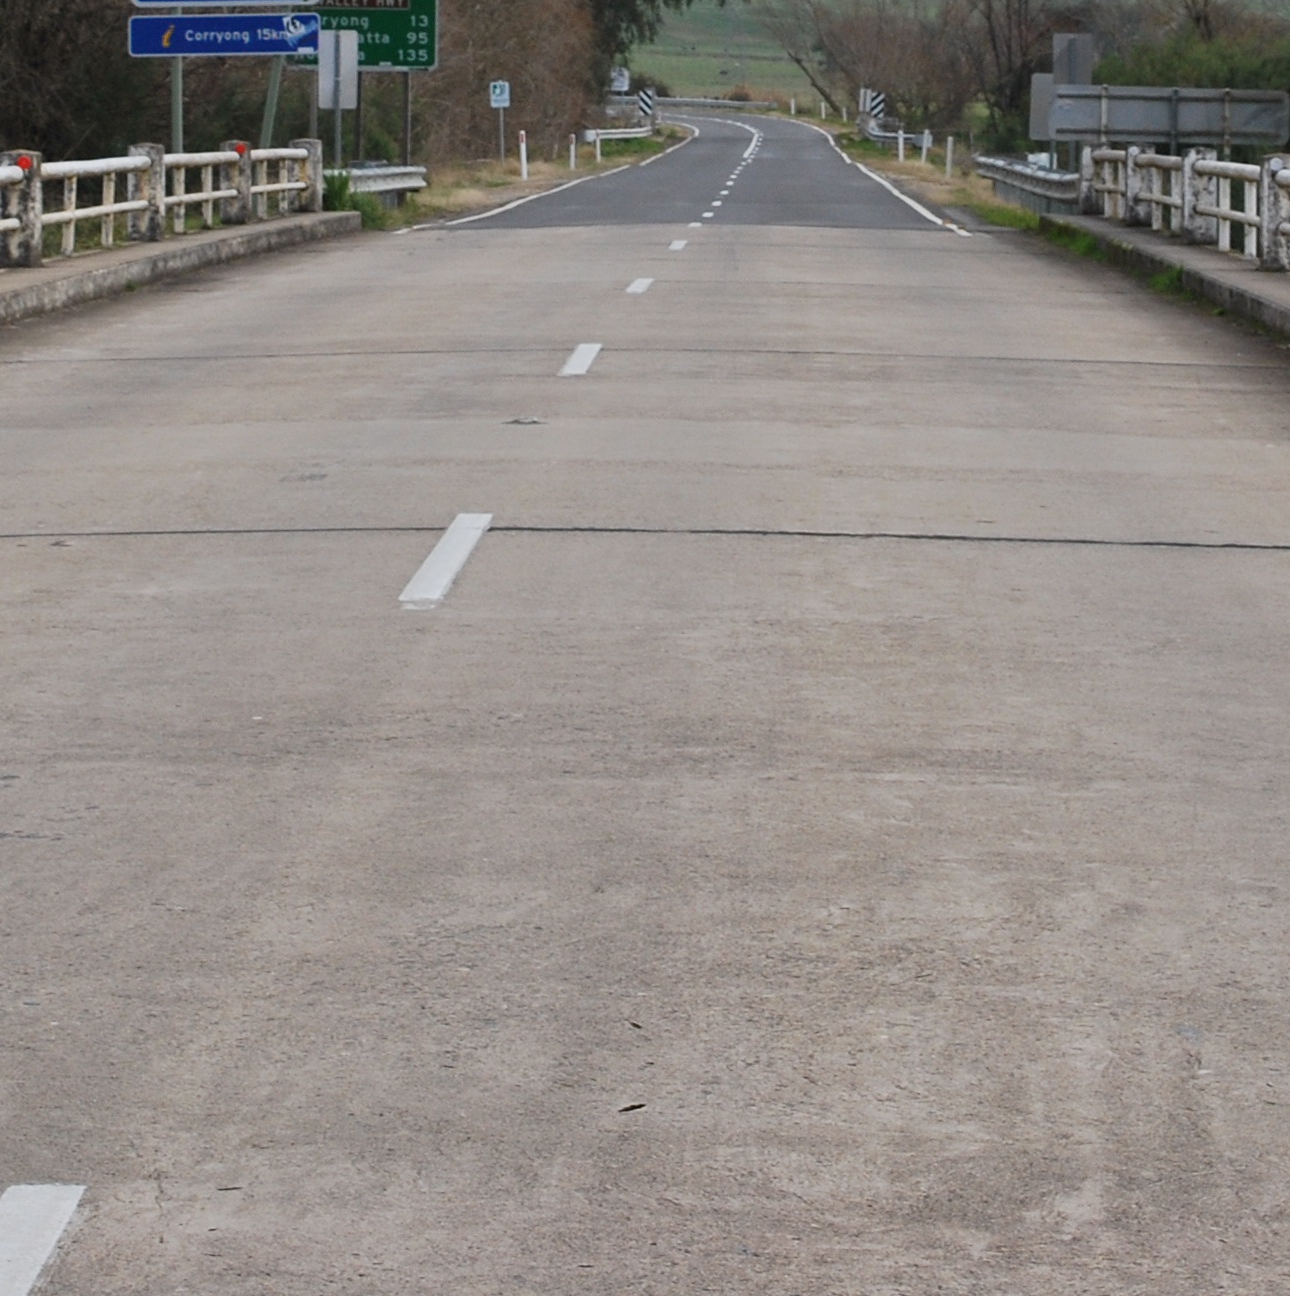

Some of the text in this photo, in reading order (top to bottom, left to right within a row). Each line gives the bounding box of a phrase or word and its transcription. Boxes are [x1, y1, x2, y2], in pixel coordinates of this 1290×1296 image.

[411, 15, 428, 27] 13
[185, 29, 249, 43] Corryong
[406, 32, 428, 45] 95
[398, 49, 428, 62] 135
